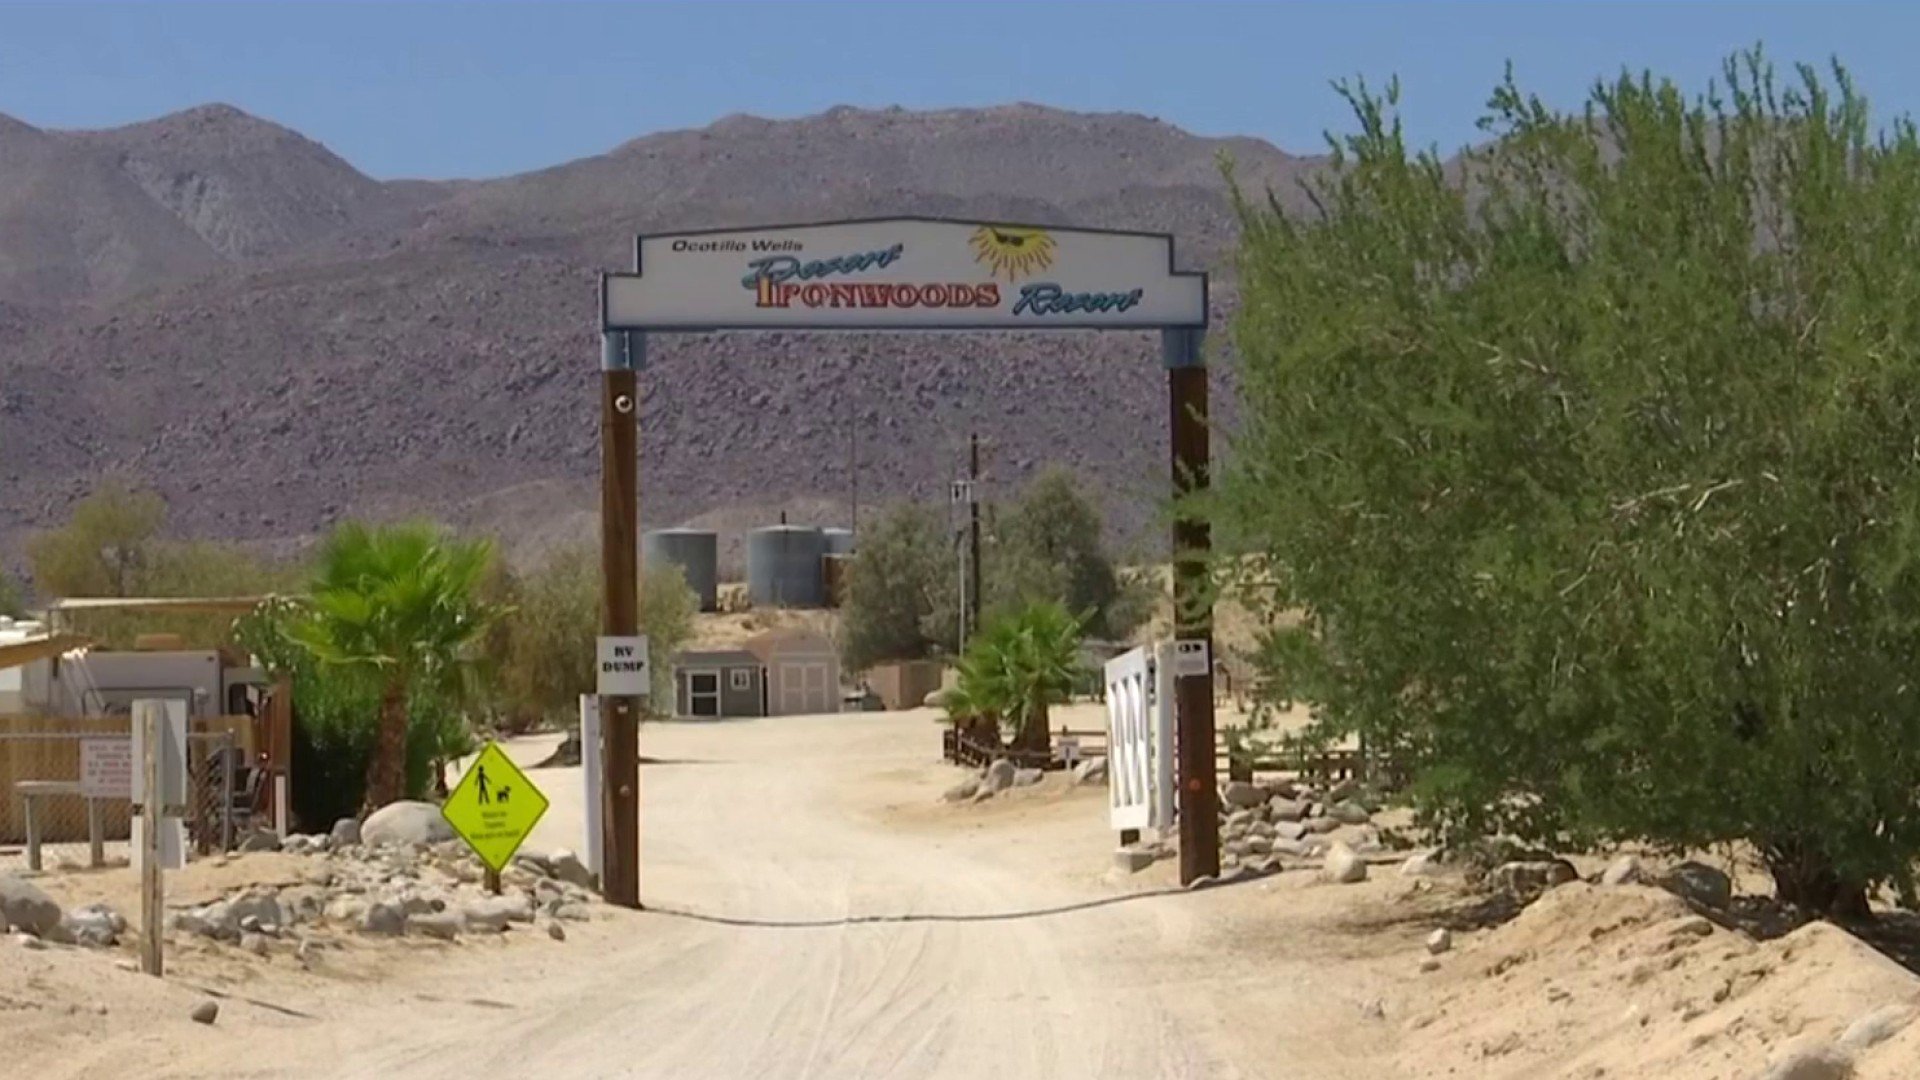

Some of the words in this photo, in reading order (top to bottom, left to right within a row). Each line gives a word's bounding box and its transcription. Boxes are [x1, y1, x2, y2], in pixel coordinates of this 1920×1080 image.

[671, 239, 747, 252] Ocotillo
[751, 239, 803, 252] Wells
[741, 243, 904, 290] Desert
[1012, 282, 1143, 315] Resort
[614, 645, 634, 657] RV
[602, 660, 644, 672] DUMP
